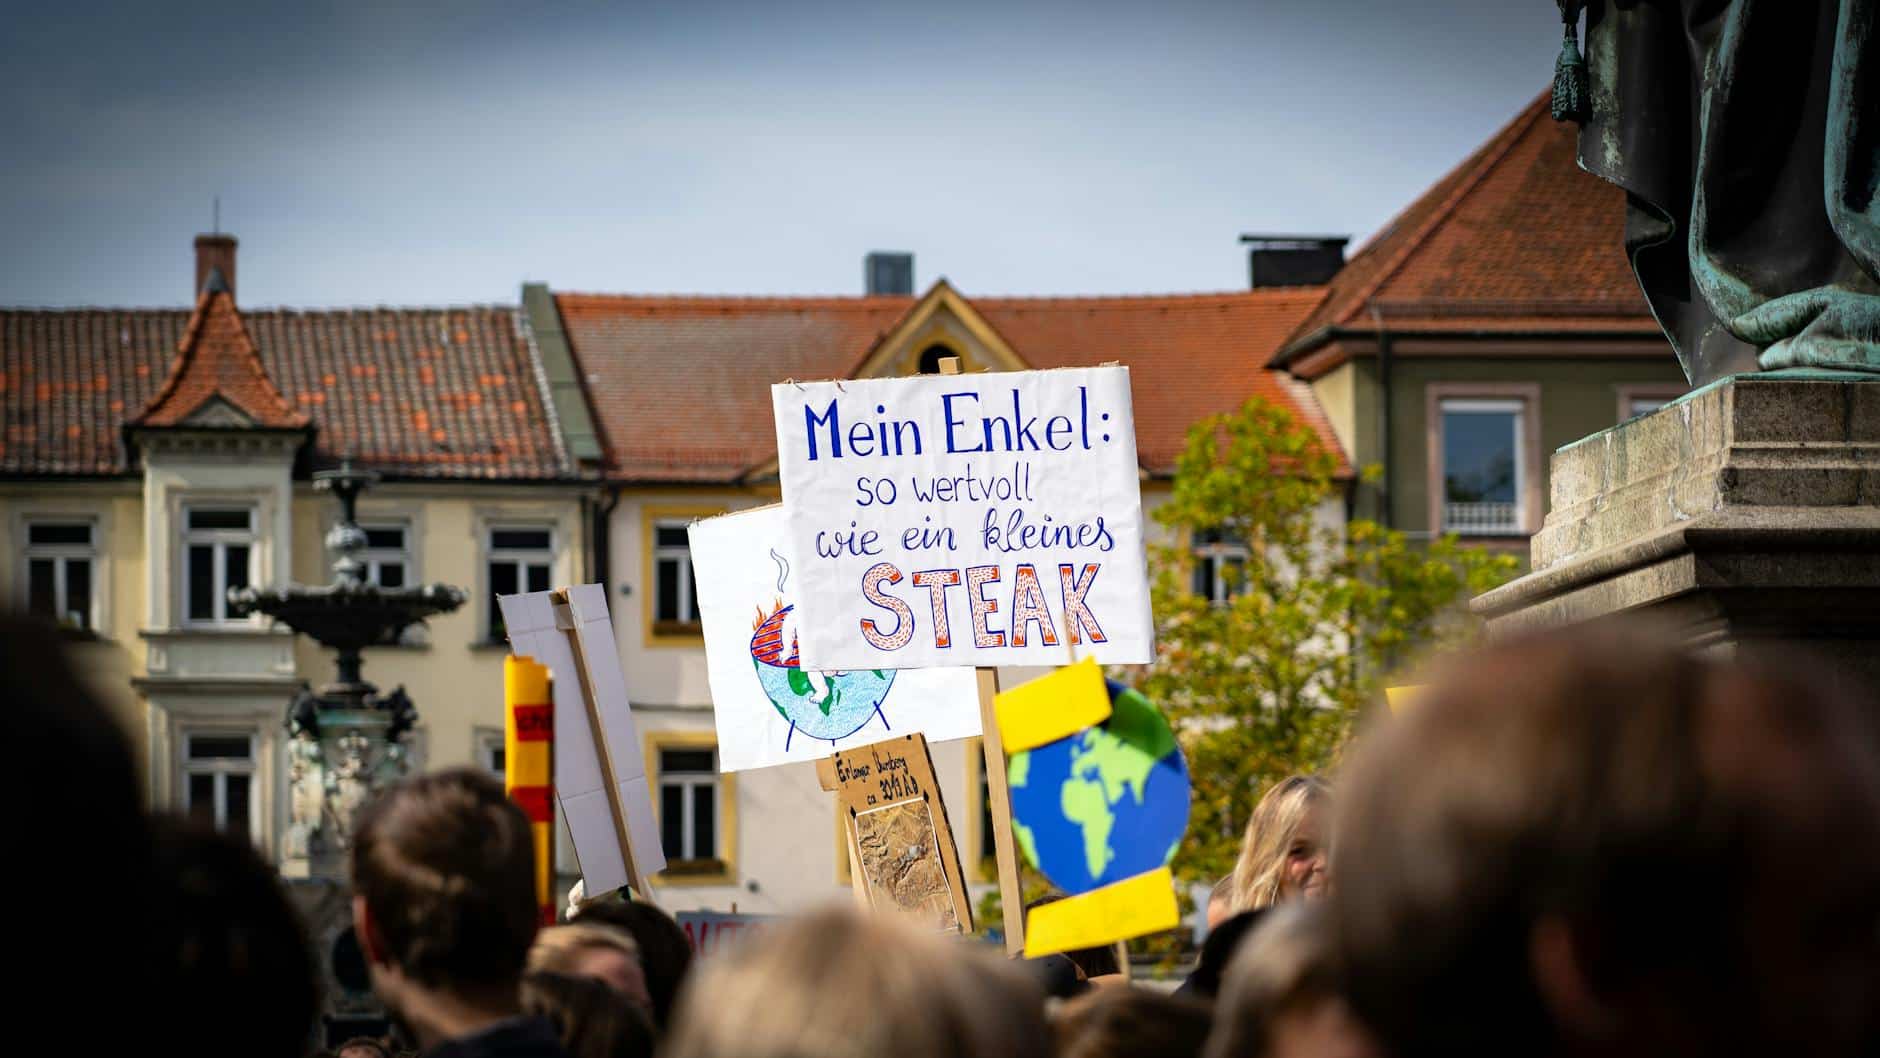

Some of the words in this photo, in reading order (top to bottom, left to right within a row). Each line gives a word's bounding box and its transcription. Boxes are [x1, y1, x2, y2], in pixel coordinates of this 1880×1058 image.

[804, 398, 923, 461] Mein
[941, 386, 1110, 454] Enkel:
[856, 475, 897, 507] so
[912, 461, 1033, 502] wertvoll
[815, 520, 883, 558] wie
[901, 515, 957, 551] ein
[980, 507, 1115, 553] kleines
[860, 562, 1108, 652] STEAK
